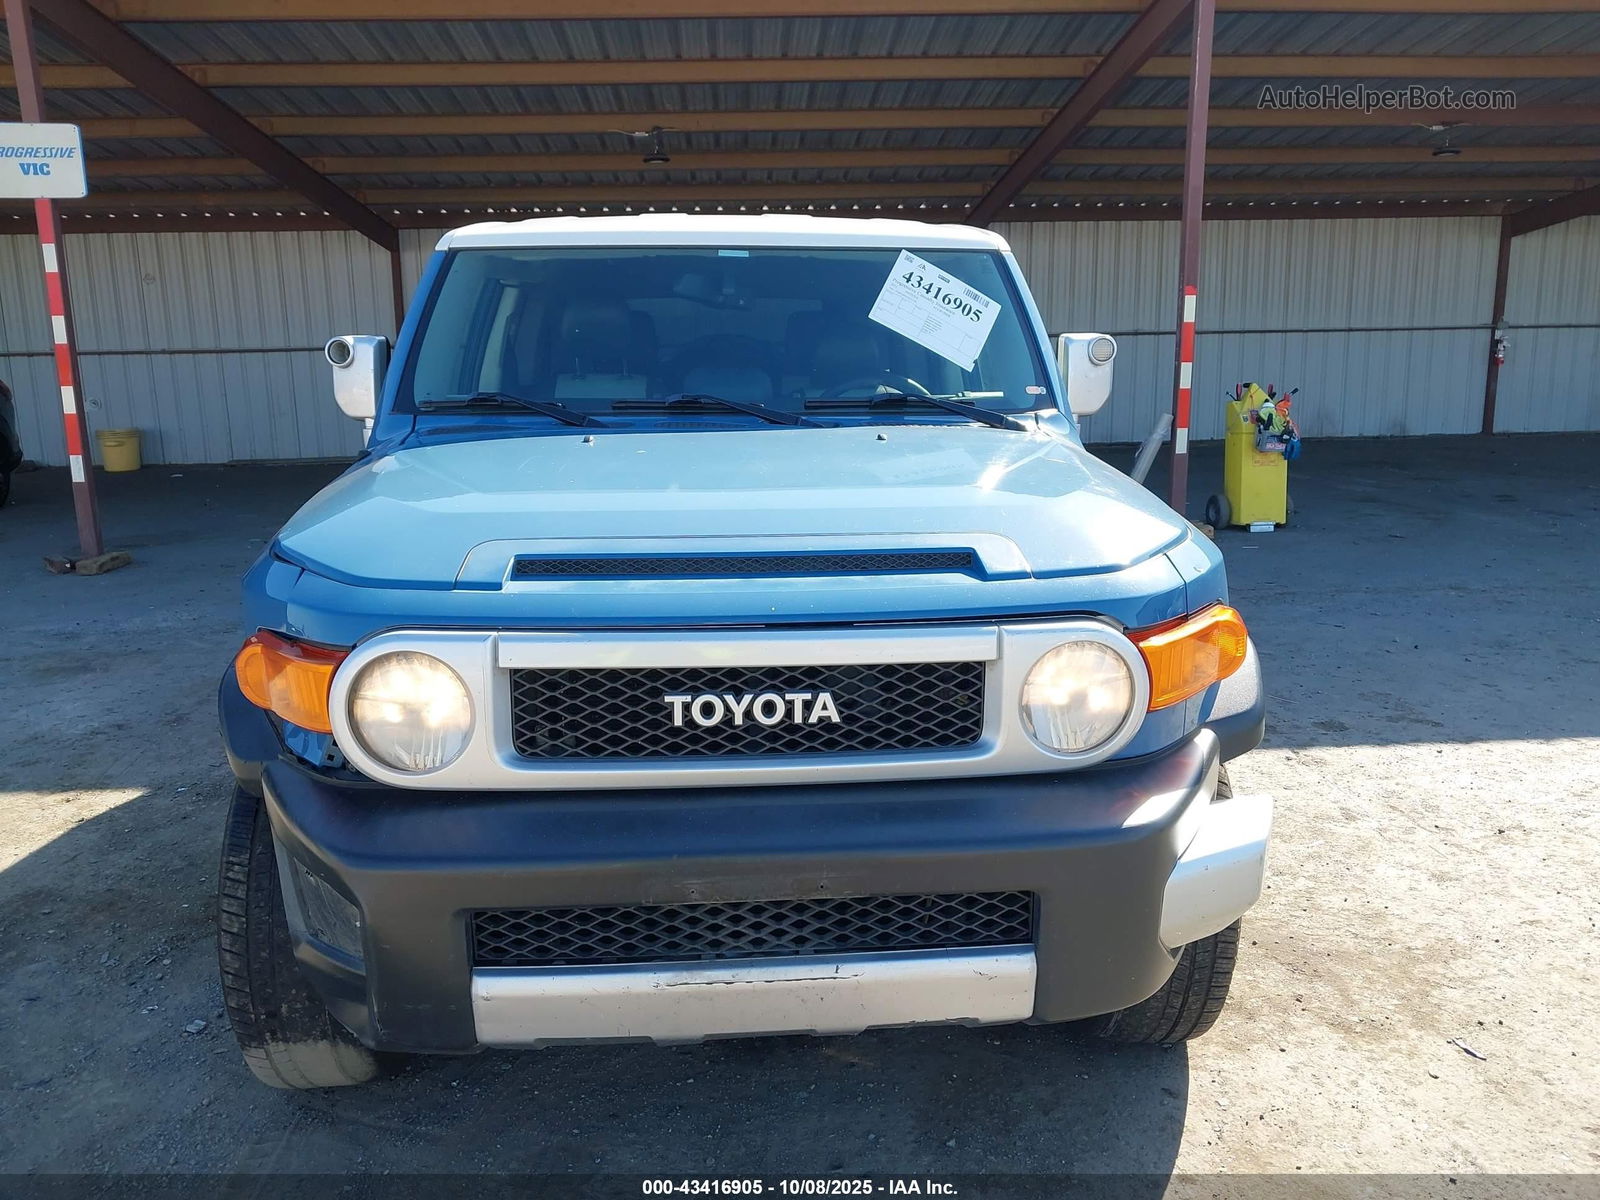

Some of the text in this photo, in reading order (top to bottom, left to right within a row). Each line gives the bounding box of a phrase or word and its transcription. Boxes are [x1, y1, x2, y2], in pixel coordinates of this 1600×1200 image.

[19, 163, 51, 175] VIC
[902, 271, 983, 322] 43416905
[664, 692, 841, 727] TOYOTA
